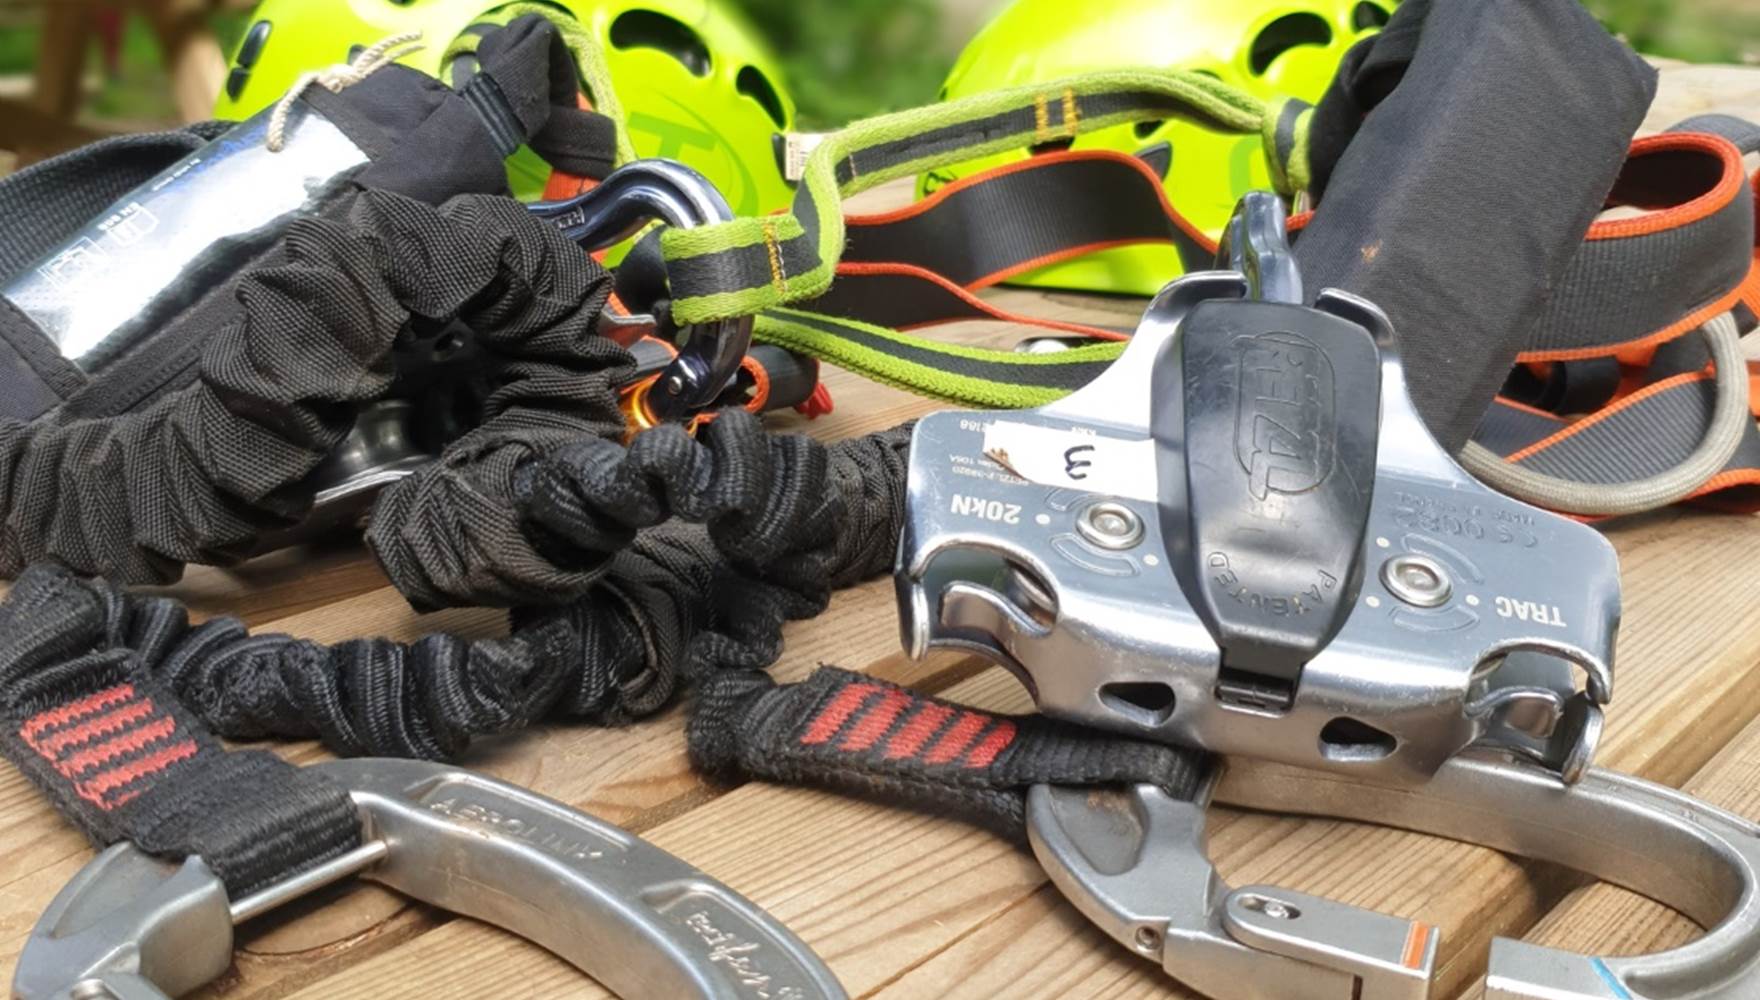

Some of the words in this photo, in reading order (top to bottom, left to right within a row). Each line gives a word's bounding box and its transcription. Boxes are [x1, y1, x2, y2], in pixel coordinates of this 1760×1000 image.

[1064, 444, 1095, 480] 3
[950, 493, 1022, 525] 20kN
[1207, 551, 1338, 617] PATENTED
[1495, 595, 1568, 628] TRAC
